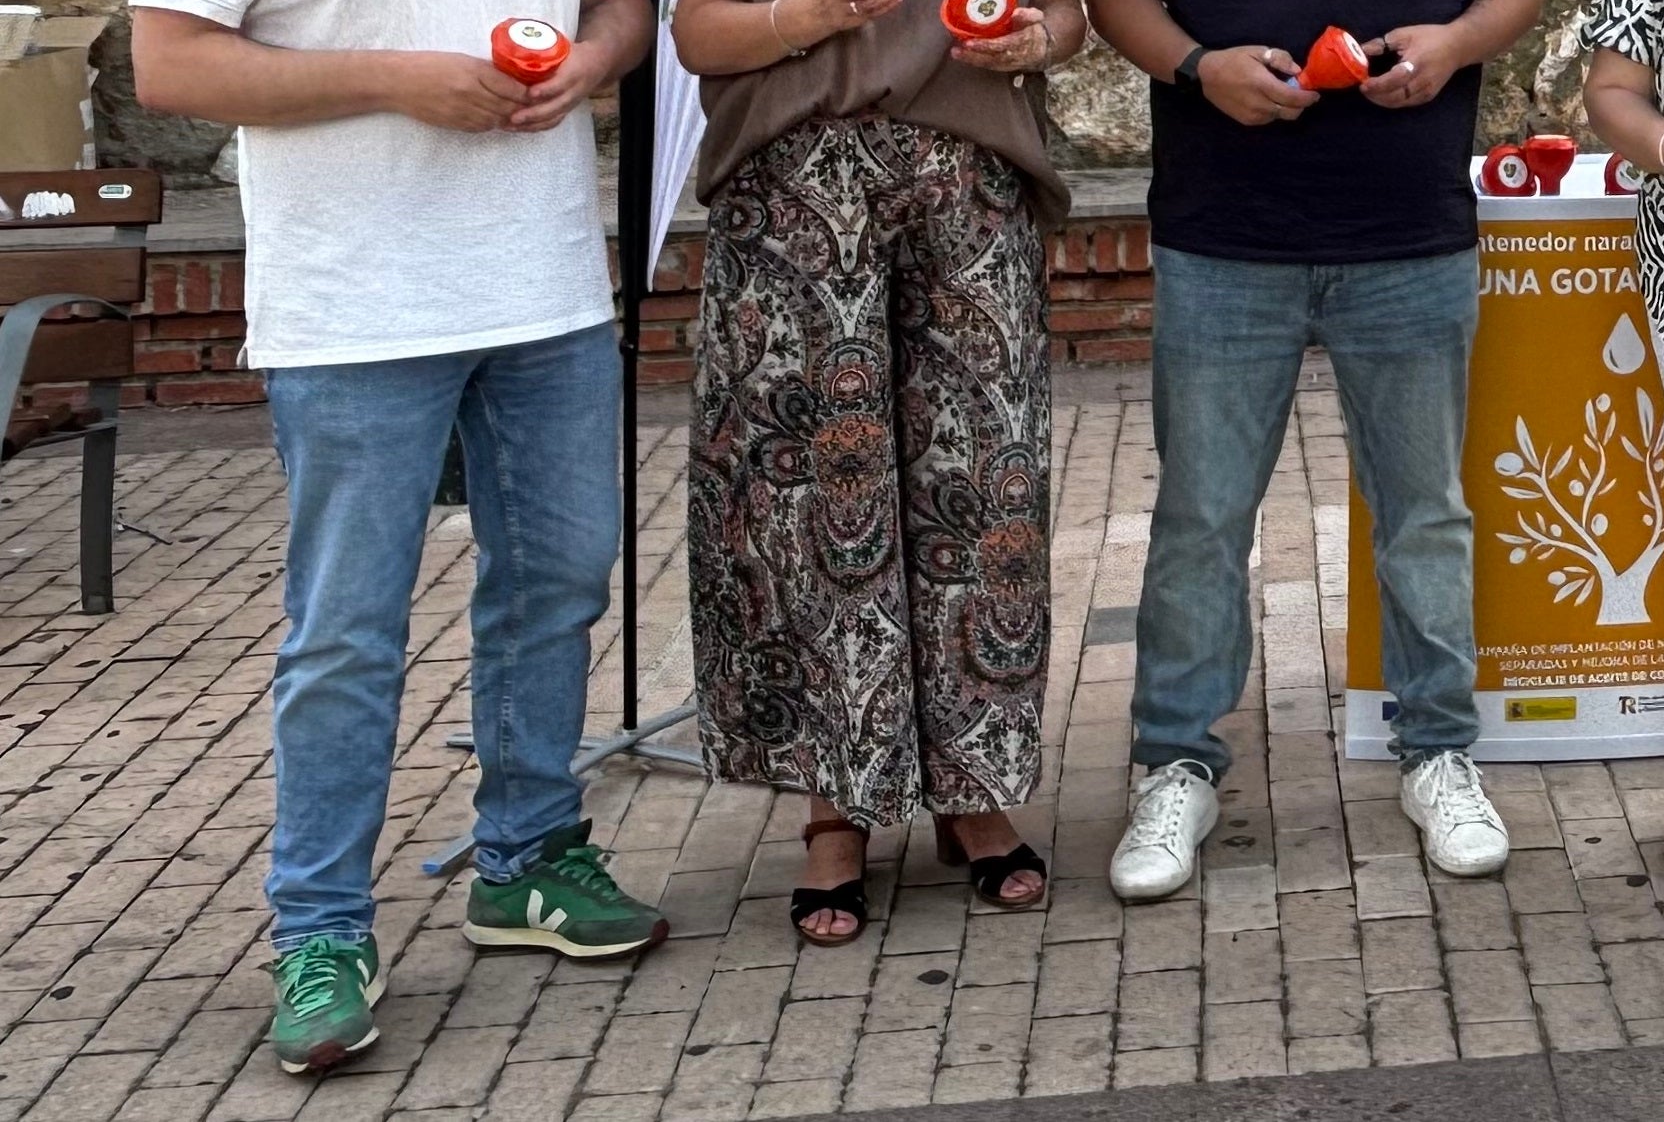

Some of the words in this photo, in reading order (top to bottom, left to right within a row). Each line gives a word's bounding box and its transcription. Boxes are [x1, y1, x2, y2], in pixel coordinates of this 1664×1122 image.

[1478, 232, 1576, 252] ntenedor
[1584, 234, 1632, 252] nara
[1551, 267, 1638, 295] GOTA
